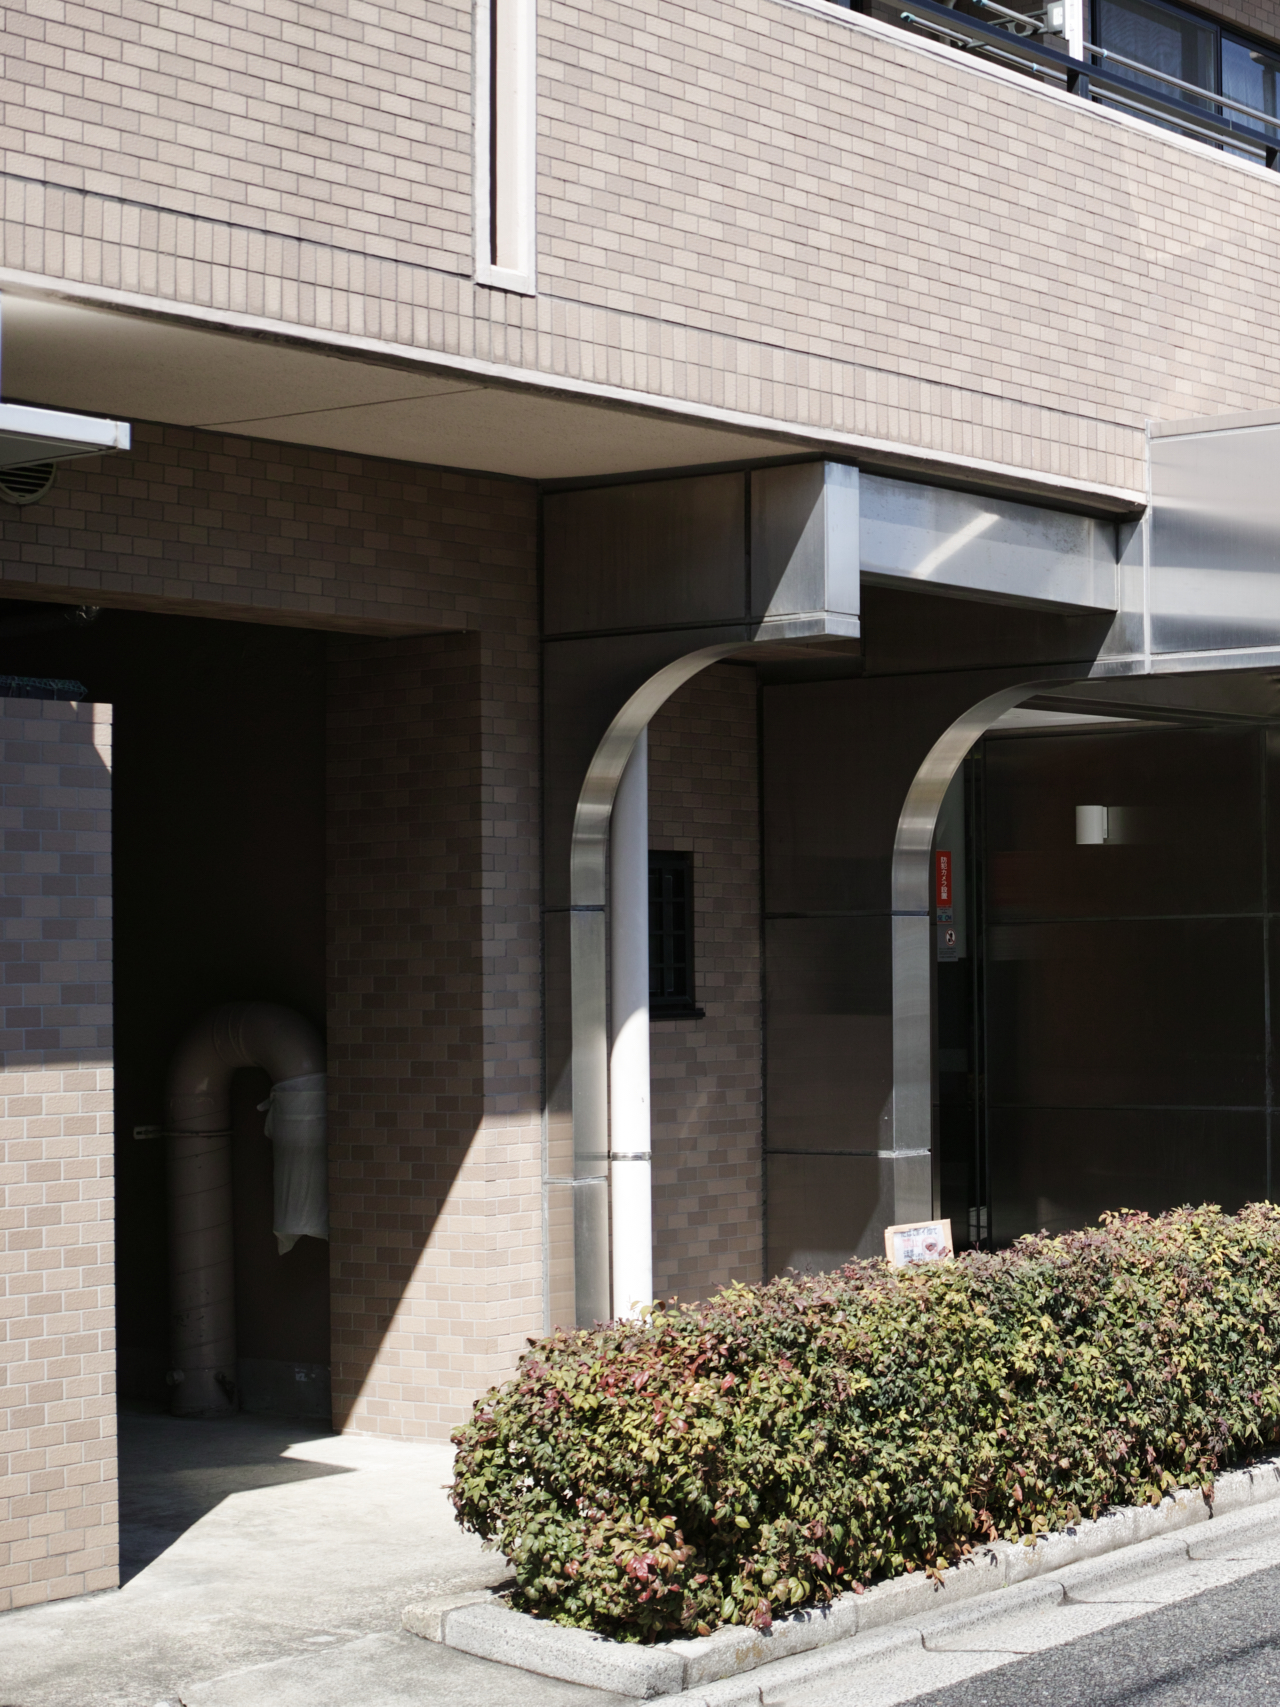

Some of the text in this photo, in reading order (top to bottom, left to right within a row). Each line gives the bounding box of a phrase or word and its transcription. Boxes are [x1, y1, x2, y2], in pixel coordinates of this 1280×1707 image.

[940, 856, 948, 900] 防犯カメラ設置
